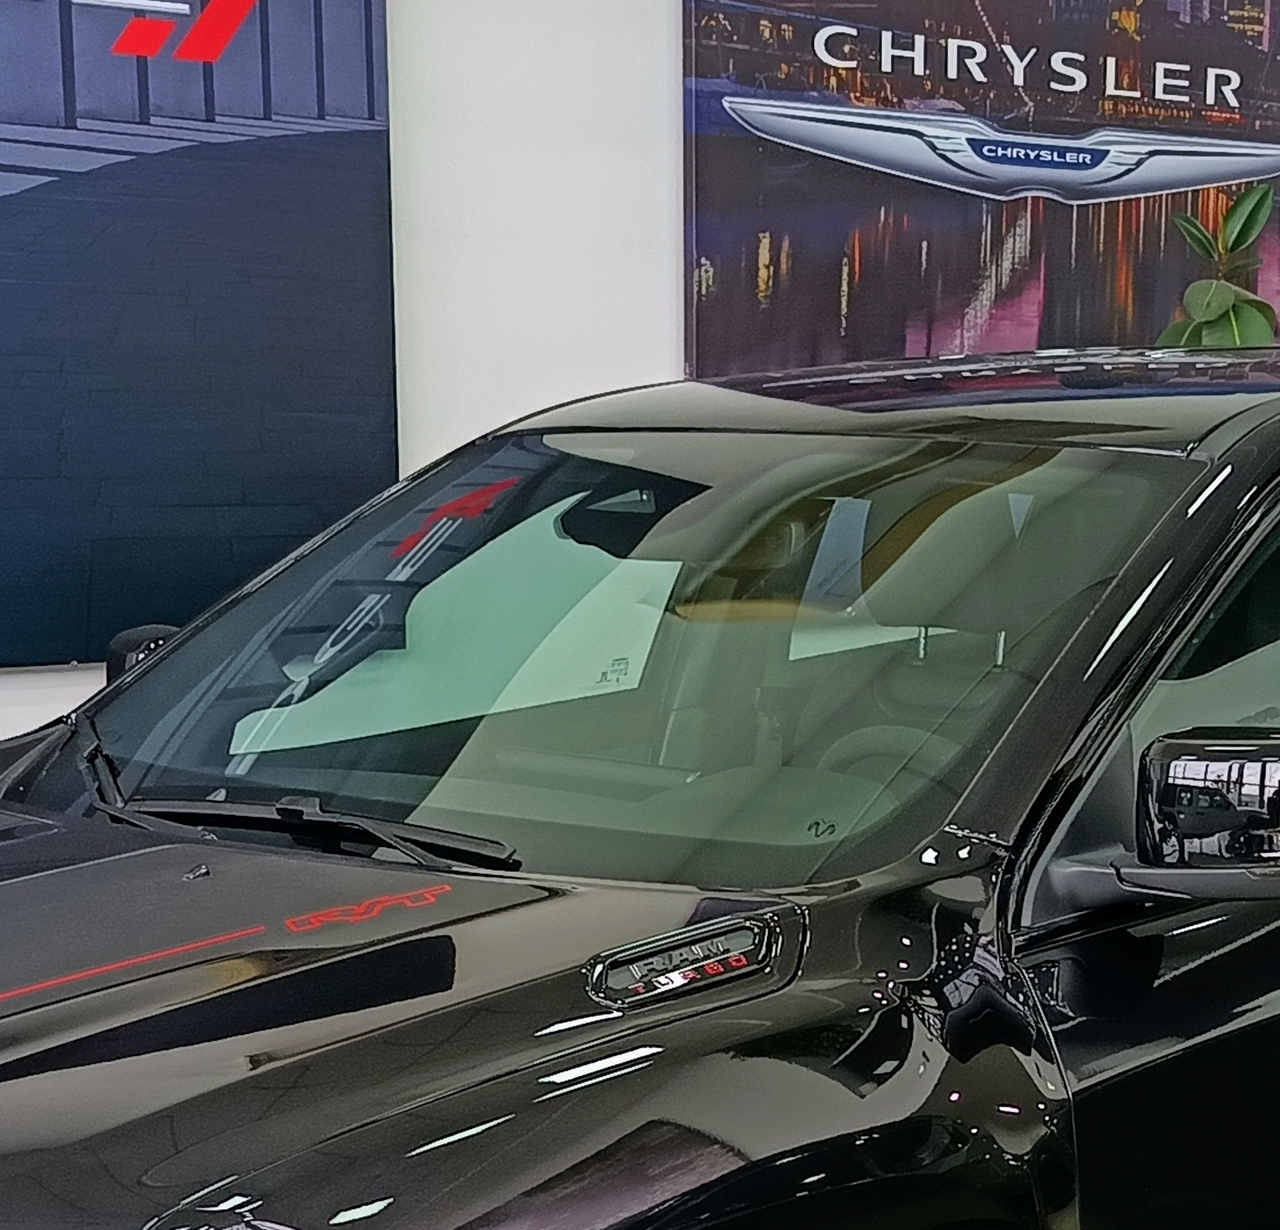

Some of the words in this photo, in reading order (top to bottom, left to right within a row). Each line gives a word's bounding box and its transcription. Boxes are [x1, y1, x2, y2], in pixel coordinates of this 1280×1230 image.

[813, 25, 1242, 107] CHRYSLER
[982, 145, 1091, 164] CHRYSLER
[629, 938, 730, 979] RAM
